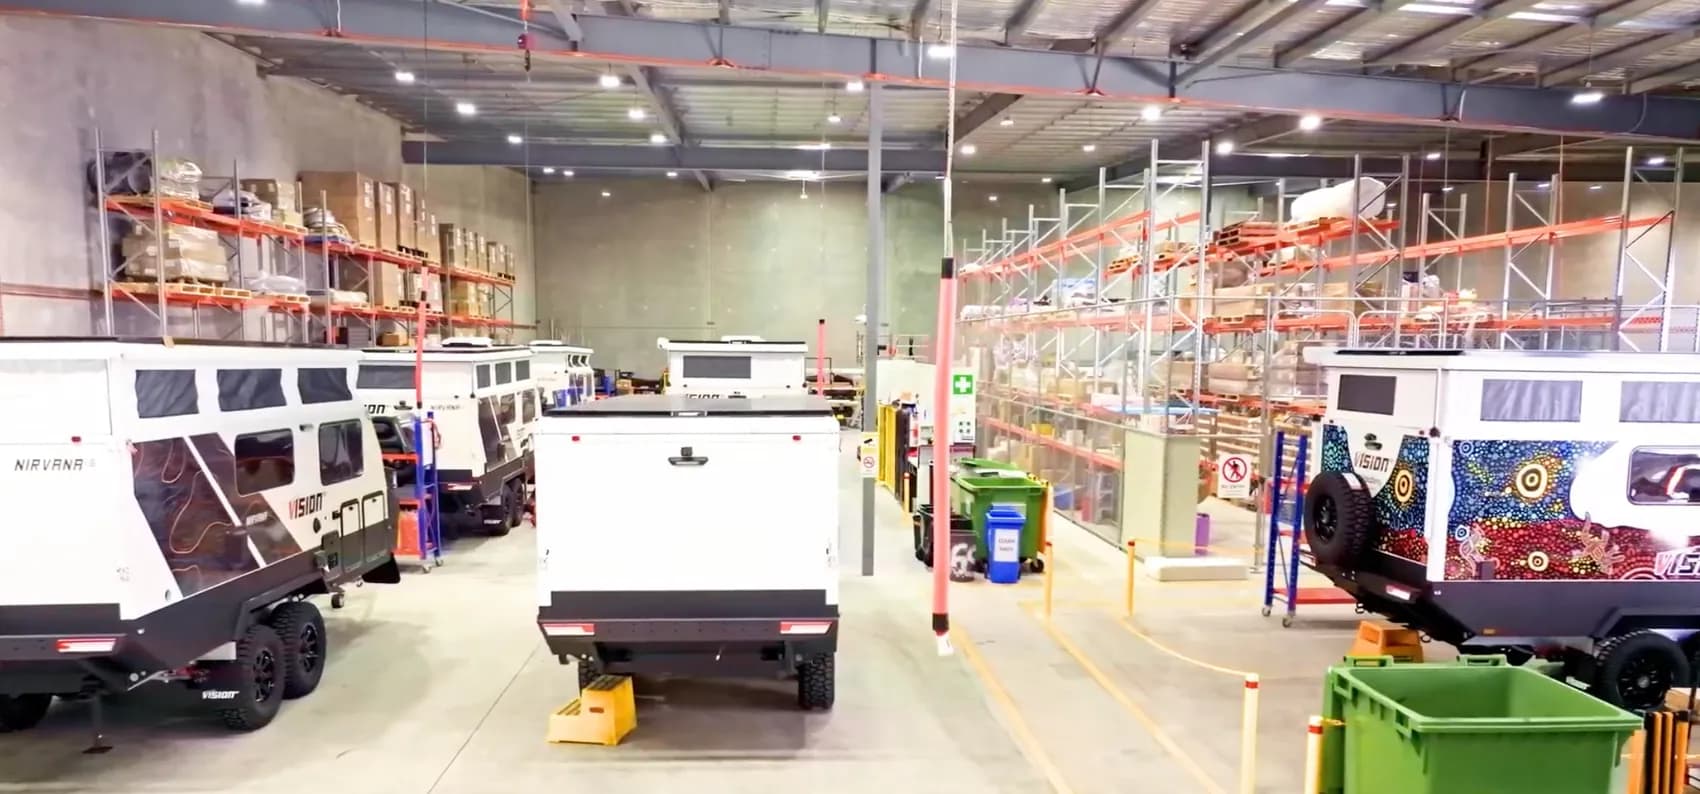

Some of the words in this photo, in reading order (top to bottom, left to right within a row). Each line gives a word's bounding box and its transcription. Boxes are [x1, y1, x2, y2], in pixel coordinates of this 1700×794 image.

[14, 458, 84, 471] NIRVANA
[1354, 451, 1389, 472] VISION
[288, 492, 323, 520] VISION
[1655, 551, 1700, 576] VIS
[202, 690, 240, 699] VISION
